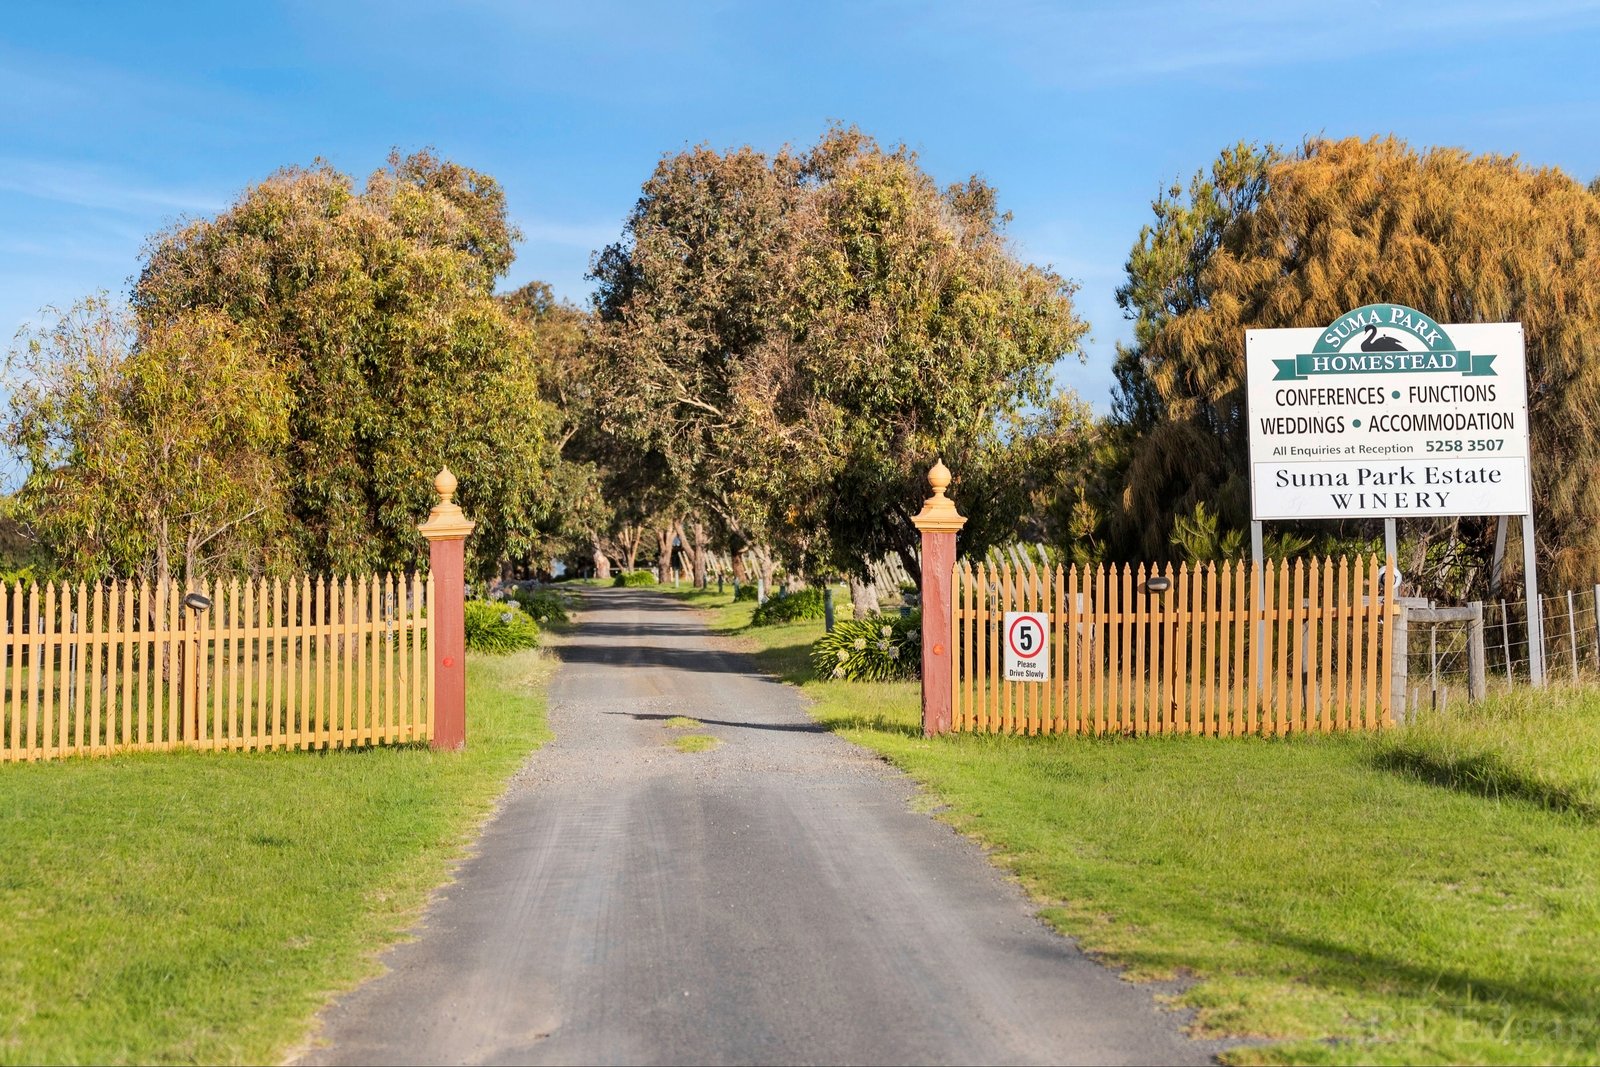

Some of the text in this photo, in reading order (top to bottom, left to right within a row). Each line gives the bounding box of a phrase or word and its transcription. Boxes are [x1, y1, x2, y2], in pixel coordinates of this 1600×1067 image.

[1325, 307, 1442, 348] SUMA PARK
[1312, 353, 1457, 372] HOMESTEAD
[1275, 384, 1496, 407] CONFERENCES FUNCTIONS
[1260, 412, 1515, 435] WEDDINGS ACCOMMODATION
[1272, 439, 1504, 457] All Enquiries at Reception 5258 3507
[1276, 466, 1502, 488] Suma Park Estate
[1330, 492, 1450, 510] WINERY
[1020, 626, 1032, 651] 5
[1009, 669, 1044, 679] Drive Slowly
[1017, 660, 1037, 668] Please
